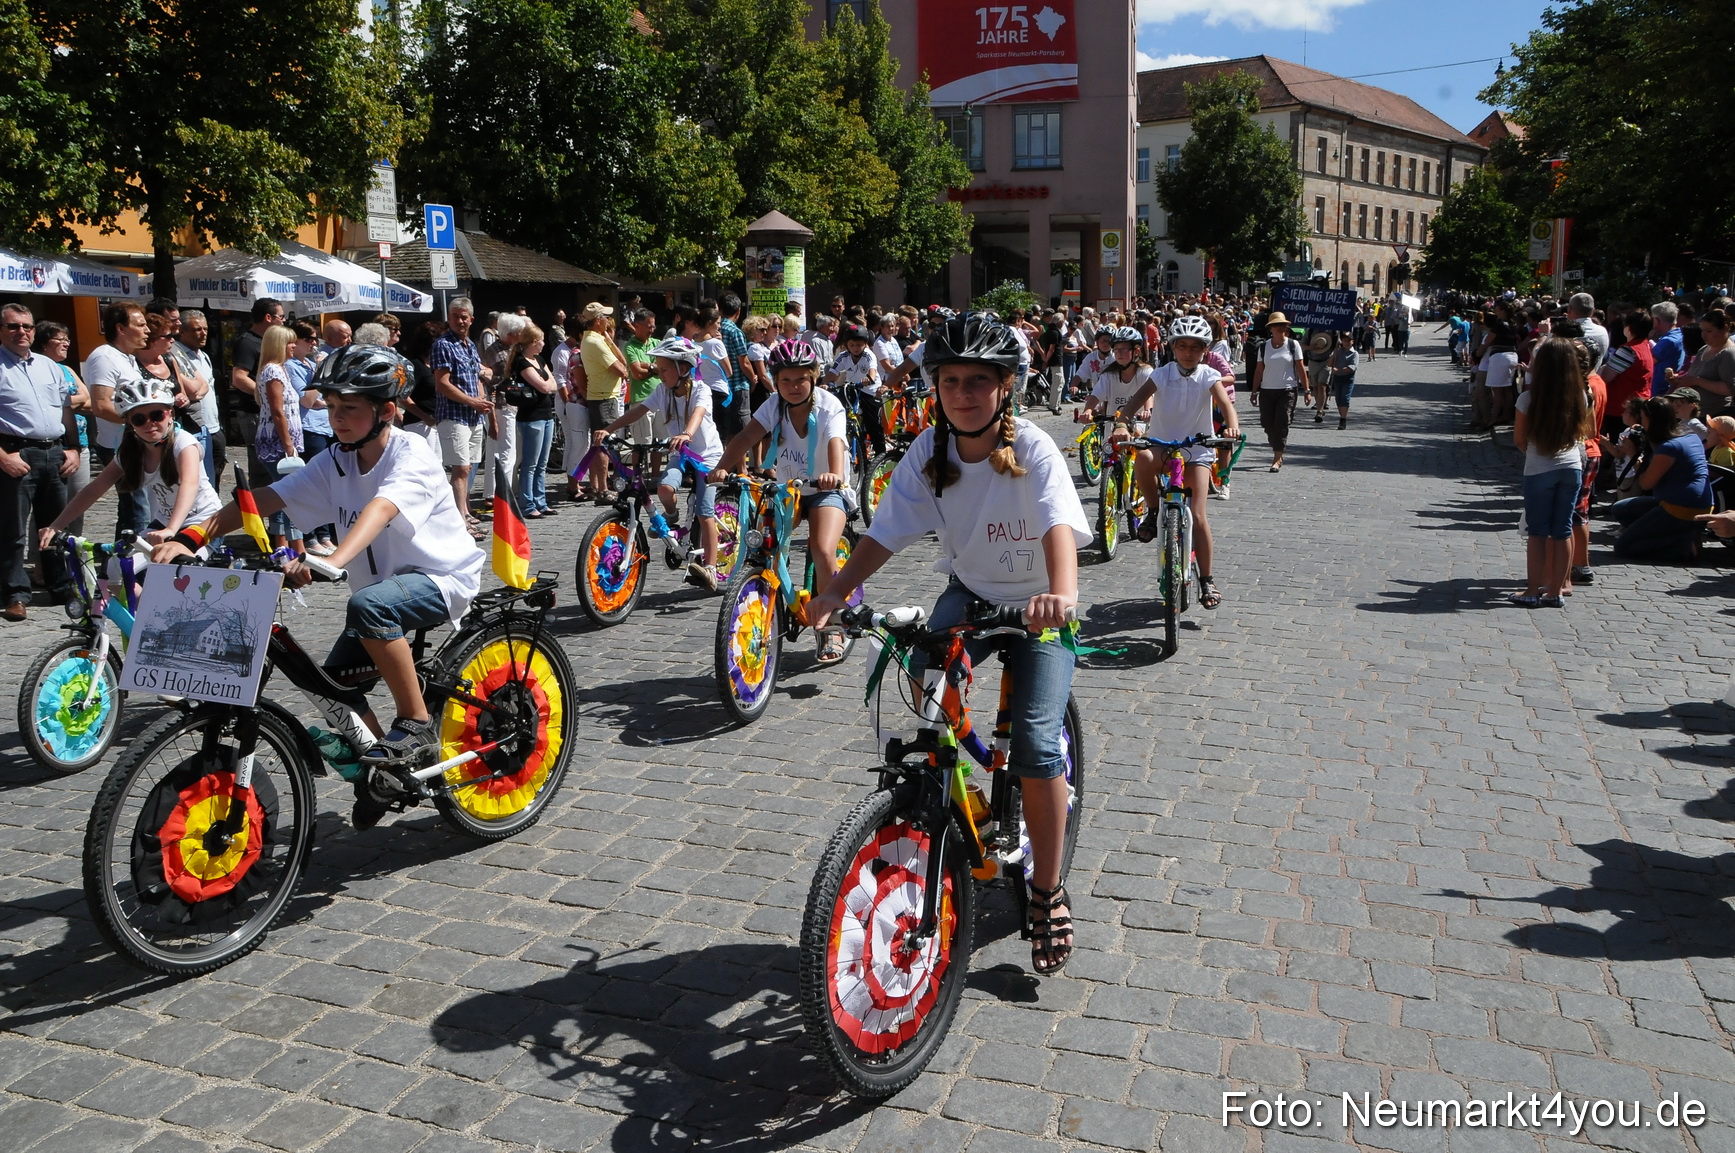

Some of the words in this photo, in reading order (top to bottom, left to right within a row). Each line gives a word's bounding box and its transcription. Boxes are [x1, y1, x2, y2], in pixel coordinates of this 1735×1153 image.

[975, 5, 1029, 30] 175
[976, 29, 1029, 45] JAHRE
[976, 51, 1006, 59] Sparkasse
[1007, 49, 1065, 58] Neumarkt-Parsberg
[431, 210, 448, 244] P
[8, 265, 32, 282] Bräu
[71, 270, 101, 287] Winkler
[103, 273, 121, 289] Bräu
[1568, 271, 1580, 279] WC
[189, 278, 219, 291] Winkler
[221, 278, 238, 292] Bräu
[265, 280, 300, 294] Winkler
[302, 281, 324, 294] Bräu
[358, 284, 389, 299] Winkl
[390, 289, 410, 303] Bräu
[1282, 288, 1323, 301] SIEDLUNG
[1324, 291, 1349, 304] TAIZE
[1310, 302, 1352, 315] hristlicher
[987, 518, 1039, 543] PAUL
[999, 550, 1035, 573] 17
[133, 667, 159, 688] GS
[161, 671, 242, 699] Holzheim
